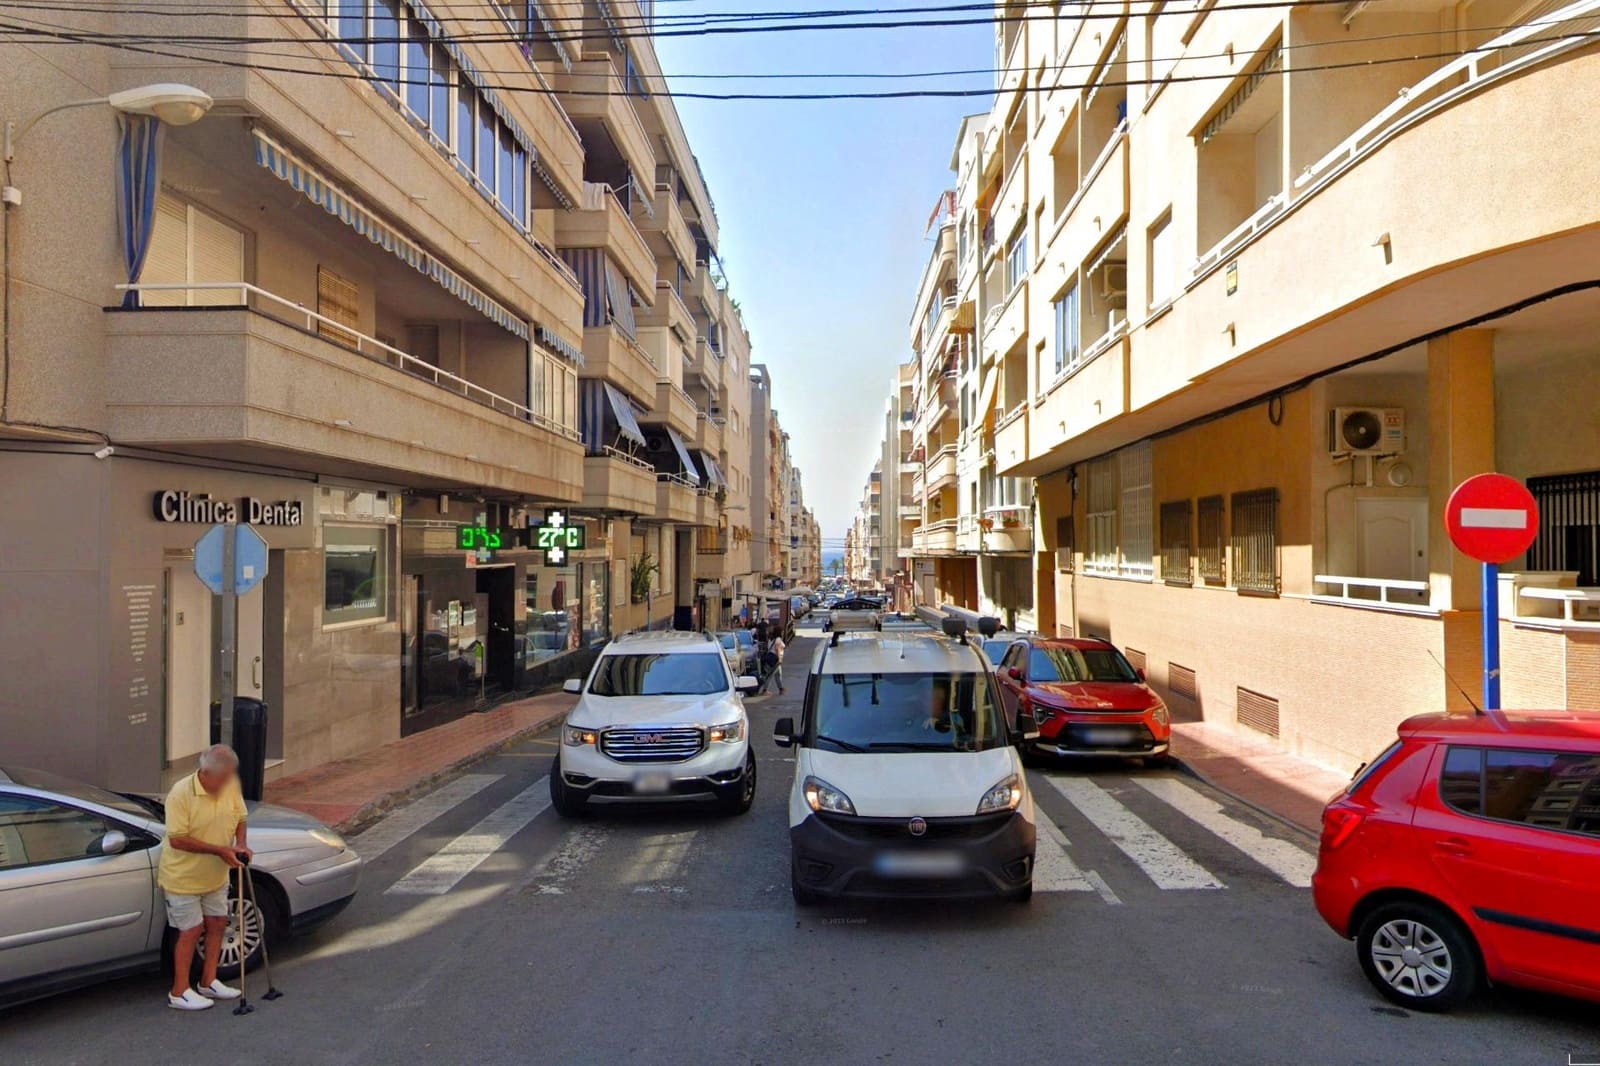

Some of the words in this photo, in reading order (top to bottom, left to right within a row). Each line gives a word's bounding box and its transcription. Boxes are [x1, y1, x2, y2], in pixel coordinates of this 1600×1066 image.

[158, 489, 237, 522] Clínica
[248, 497, 304, 525] Dental
[633, 733, 670, 744] GMC
